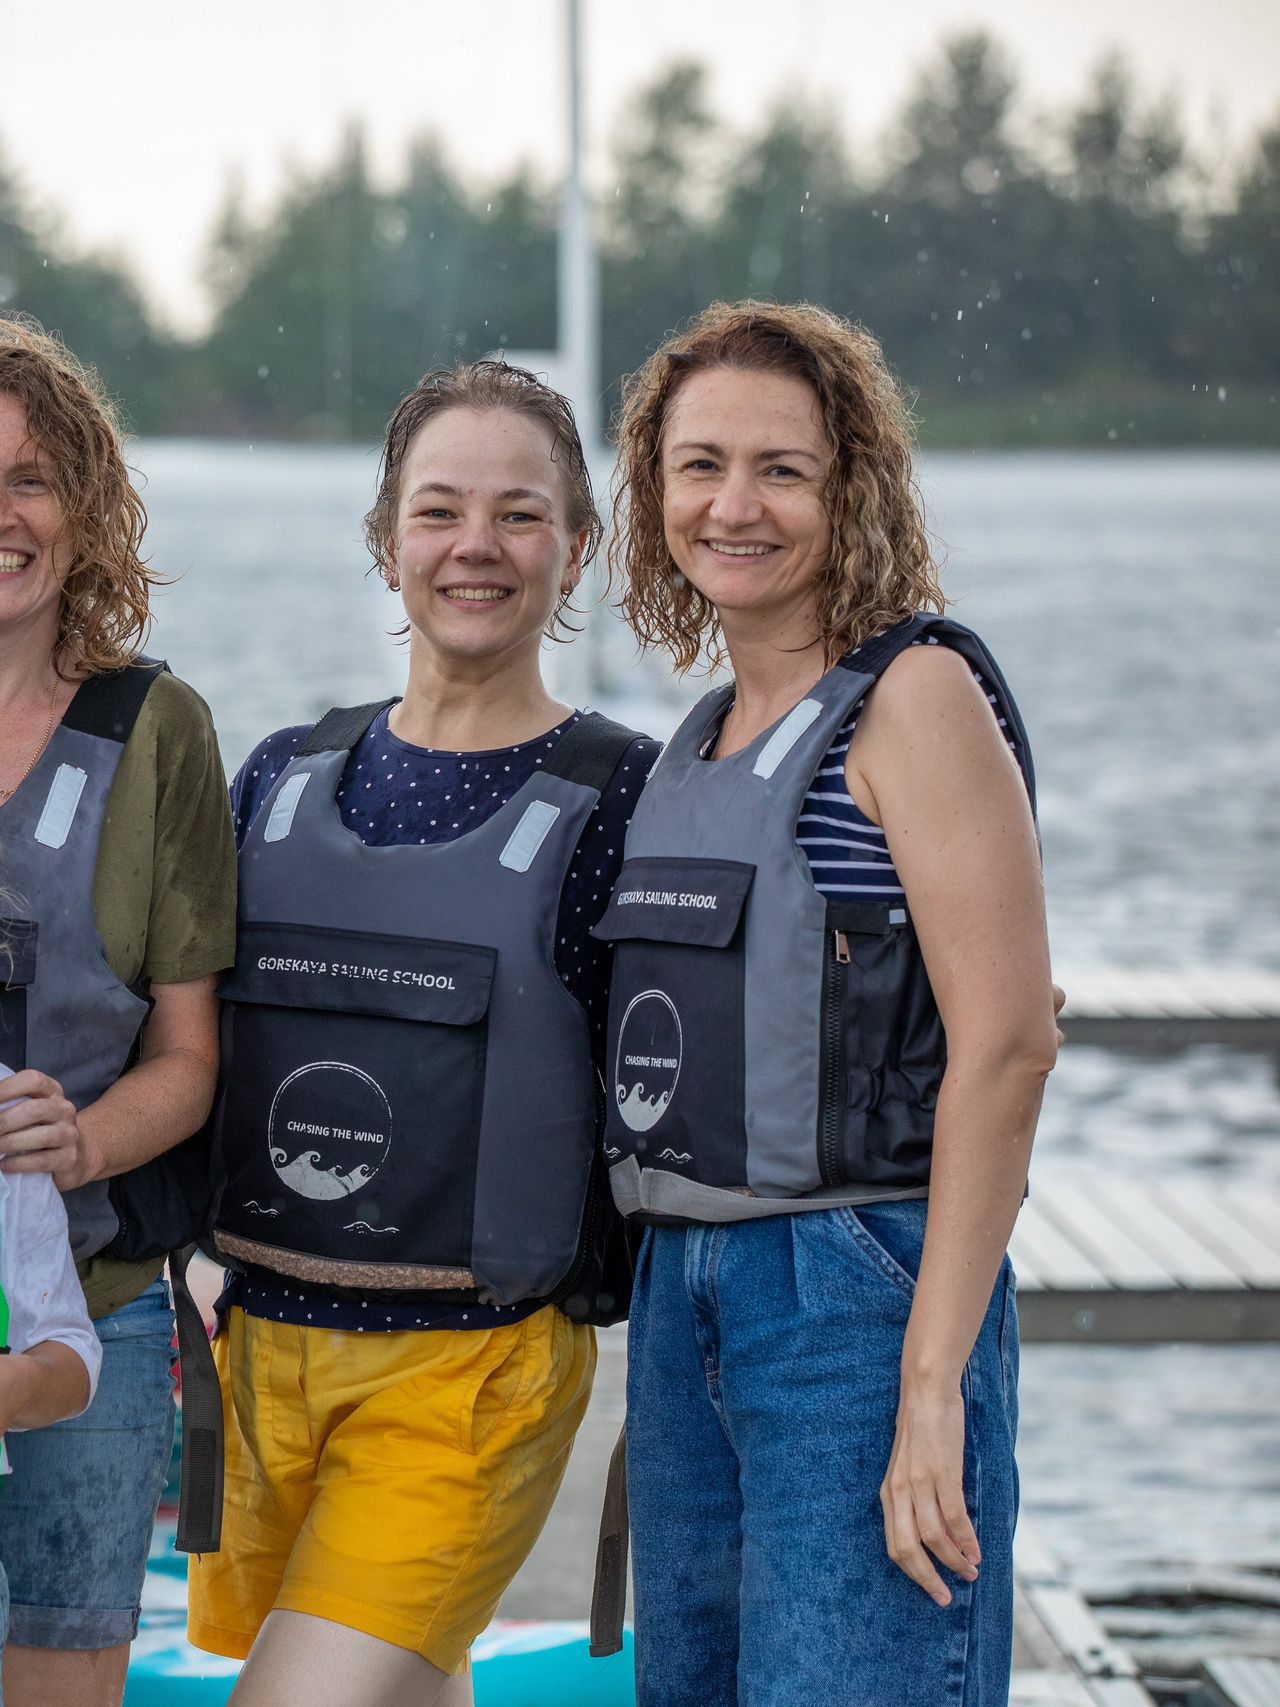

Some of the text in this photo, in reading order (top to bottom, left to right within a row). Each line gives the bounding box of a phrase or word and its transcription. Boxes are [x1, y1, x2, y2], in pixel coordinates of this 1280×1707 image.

[644, 891, 677, 906] SAILING
[678, 893, 718, 910] SCHOOL
[258, 957, 456, 990] GORSKAYA SAILING SCHOOL
[624, 1054, 678, 1069] CHASING THE WIND
[287, 1121, 384, 1144] CHASING THE WIND
